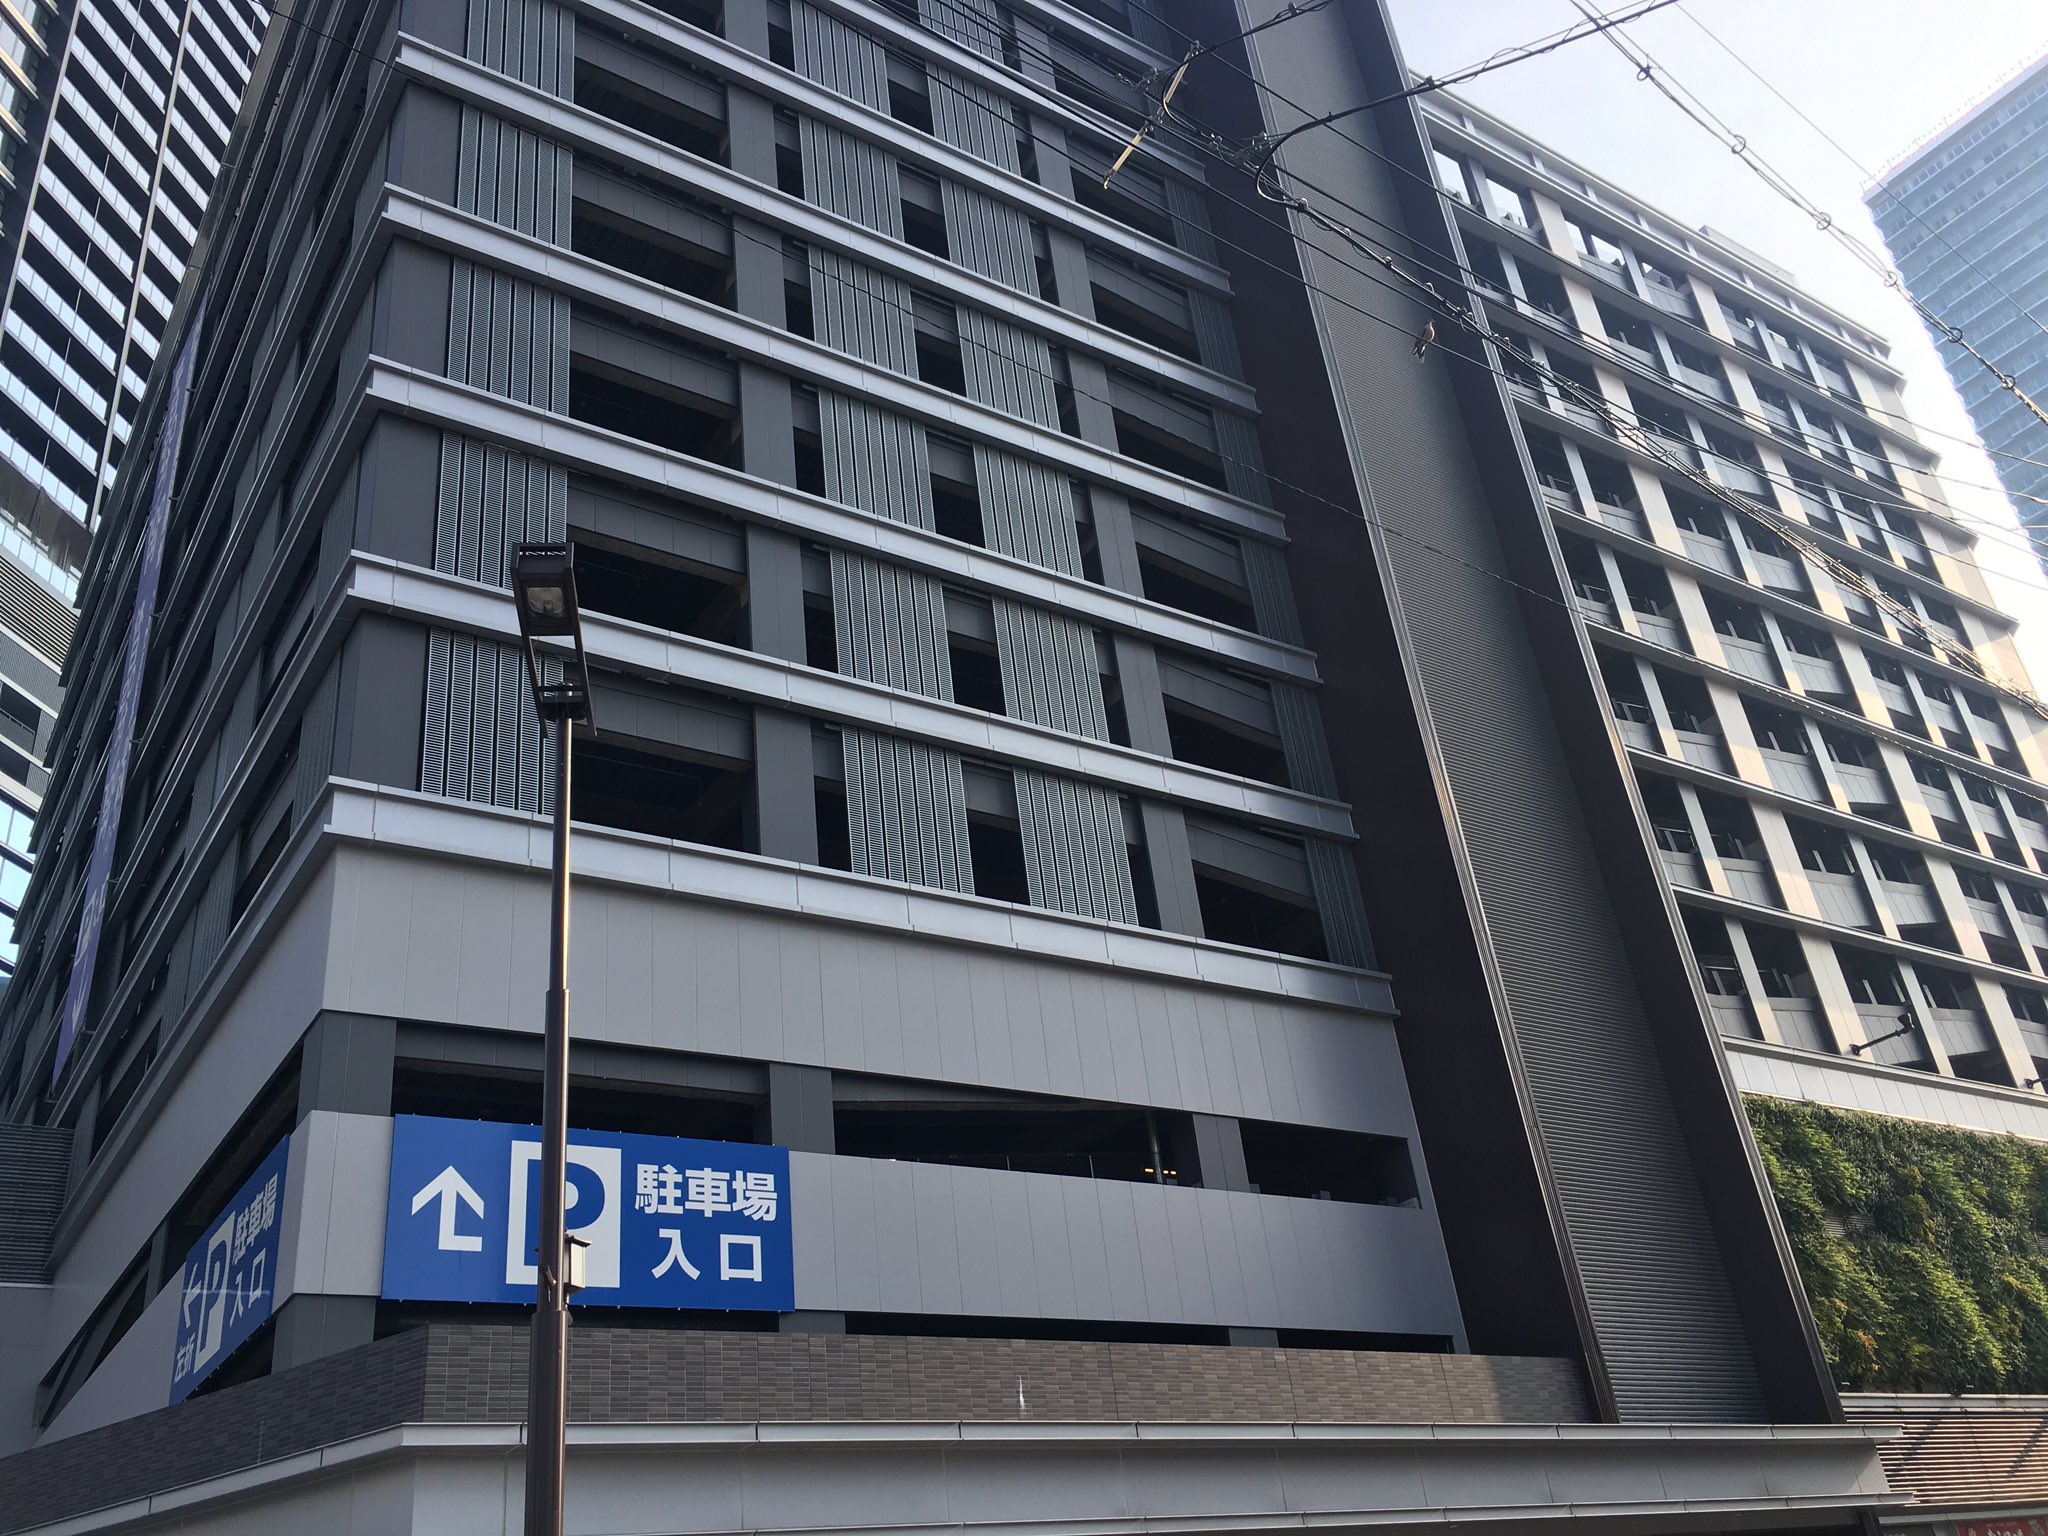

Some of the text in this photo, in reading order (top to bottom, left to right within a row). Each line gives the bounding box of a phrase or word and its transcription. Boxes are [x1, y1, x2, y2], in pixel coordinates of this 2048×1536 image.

[233, 1172, 278, 1265] 駐車場
[635, 1164, 778, 1221] 駐車場
[651, 1229, 763, 1282] 入口
[230, 1248, 266, 1328] 入口
[174, 1334, 195, 1384] 左折
